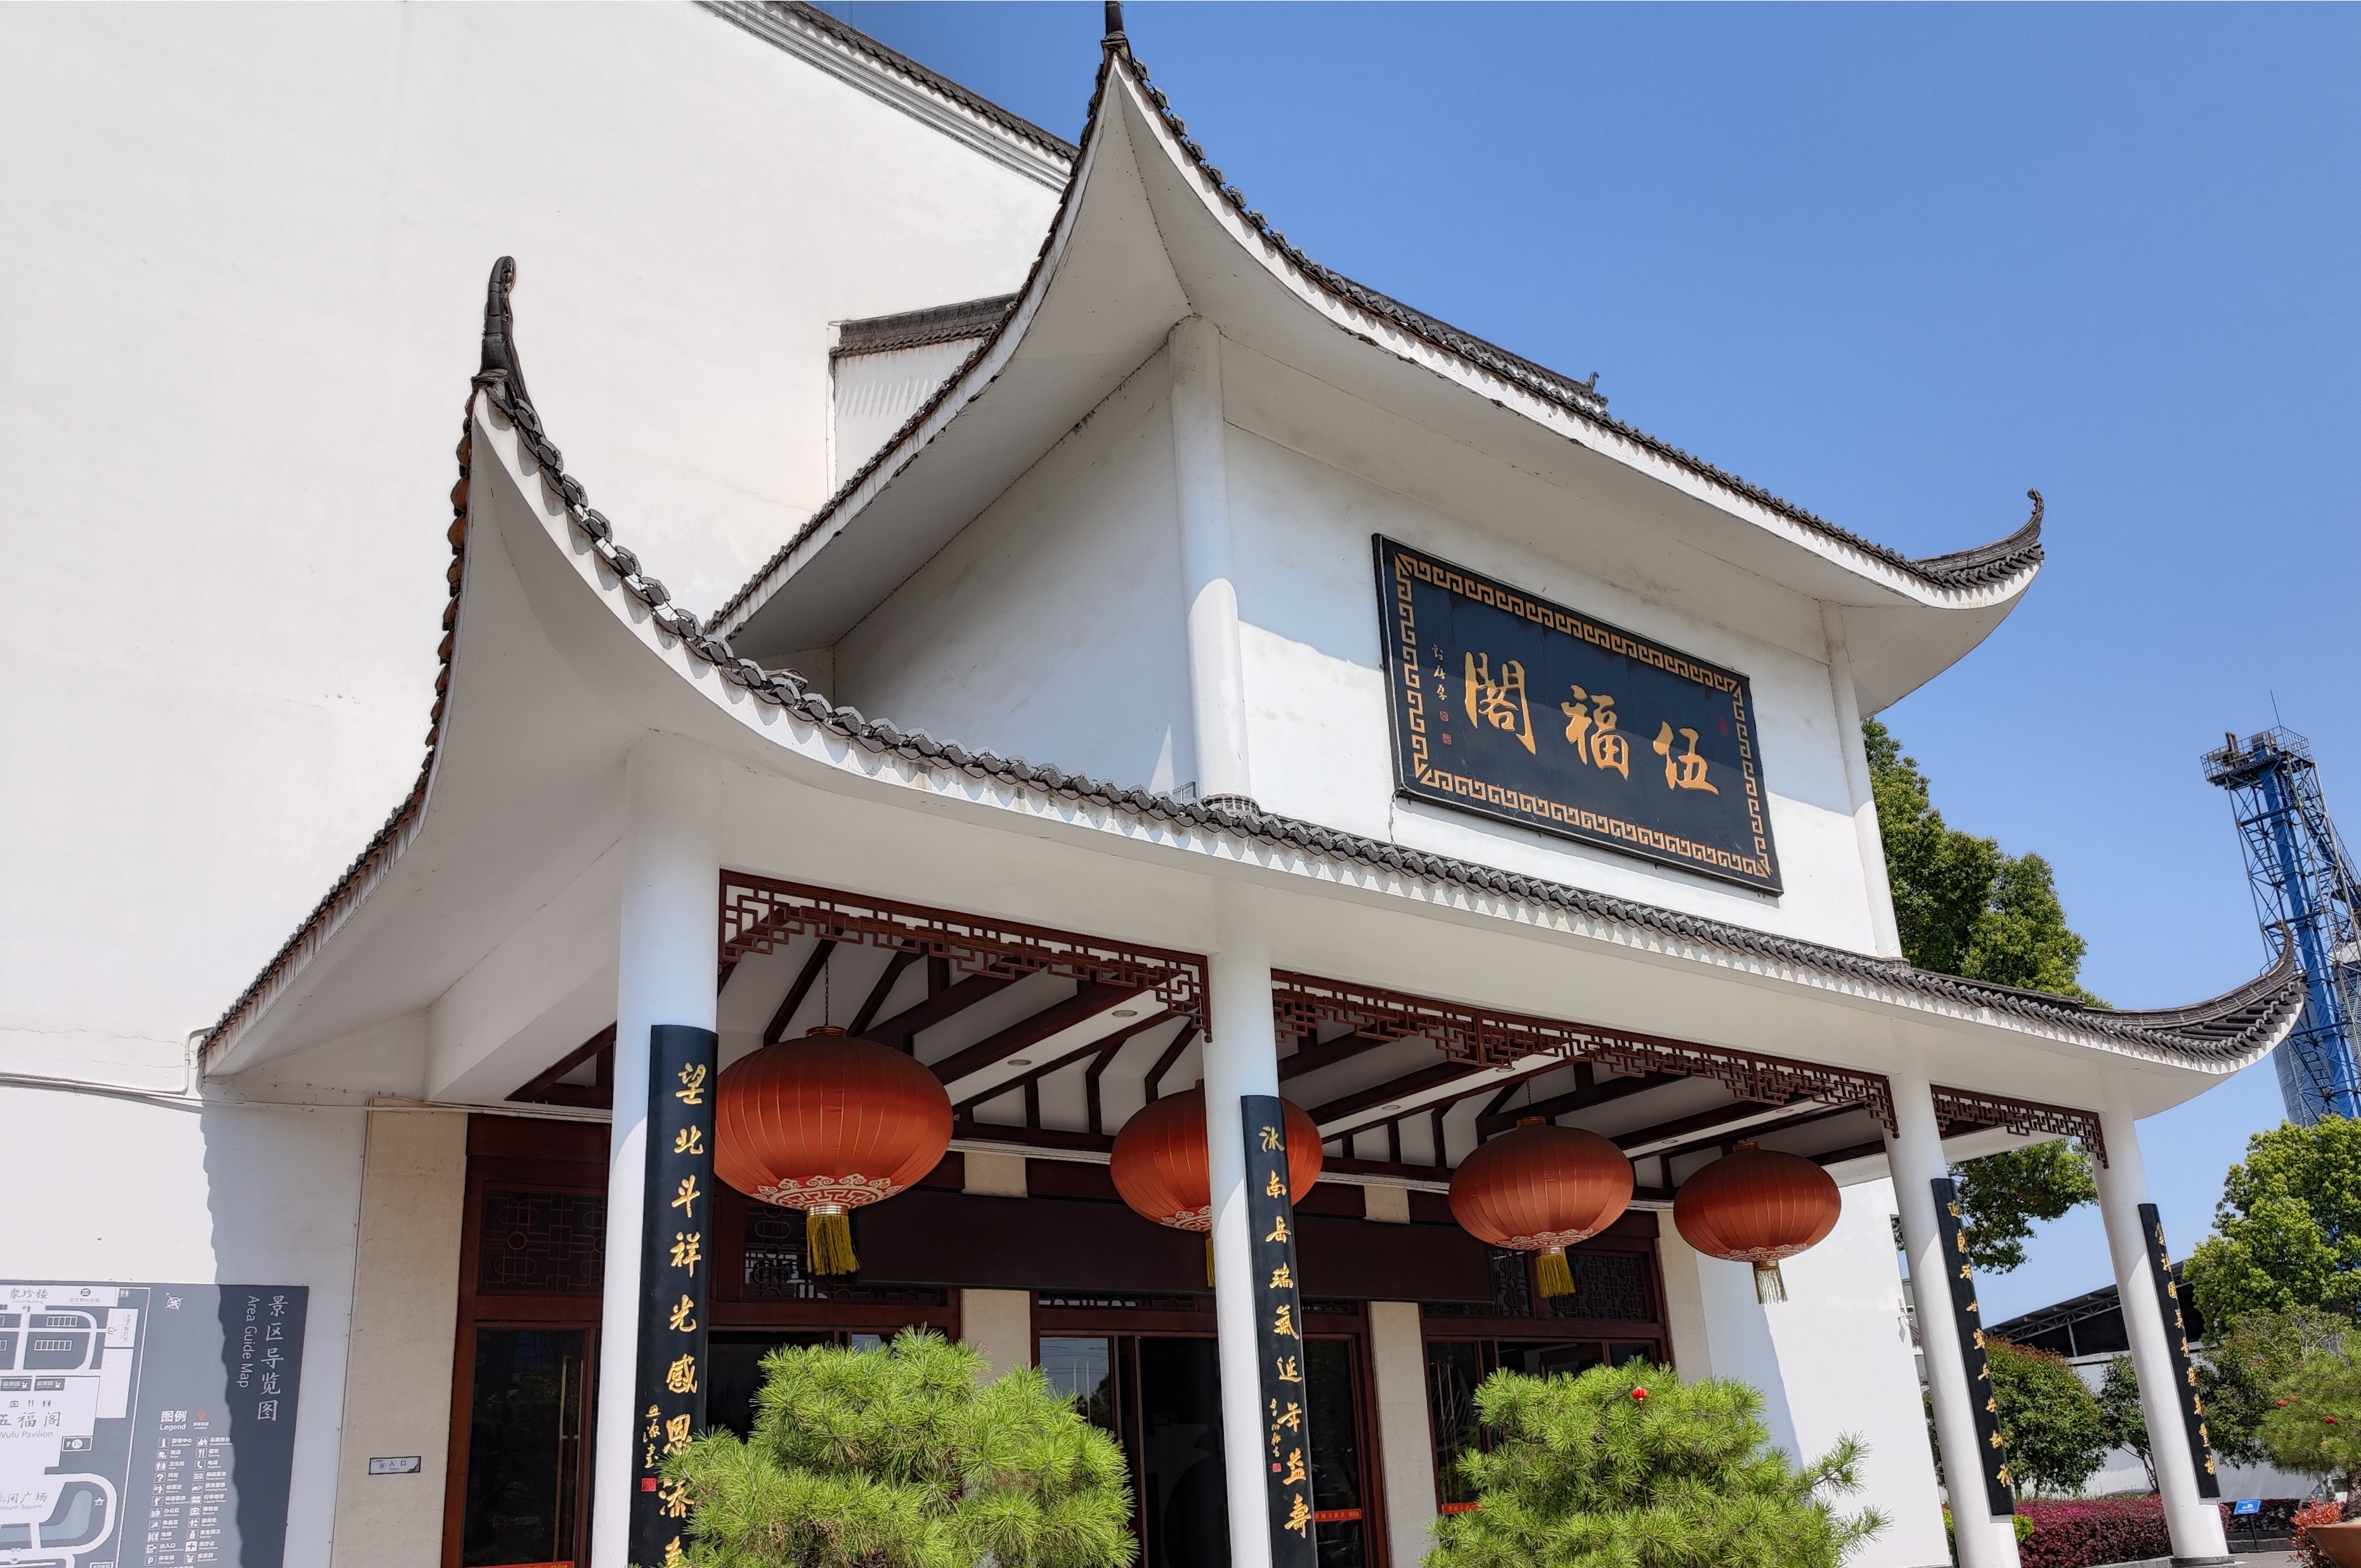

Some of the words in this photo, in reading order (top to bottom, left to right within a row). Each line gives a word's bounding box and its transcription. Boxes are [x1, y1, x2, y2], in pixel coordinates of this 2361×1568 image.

[245, 1295, 261, 1321] Area
[242, 1326, 257, 1359] Guide
[257, 1295, 289, 1422] 景区导览图
[237, 1363, 254, 1388] Map
[0, 1411, 62, 1429] 五福阁
[159, 1423, 186, 1432] Legend
[160, 1409, 188, 1422] 图例
